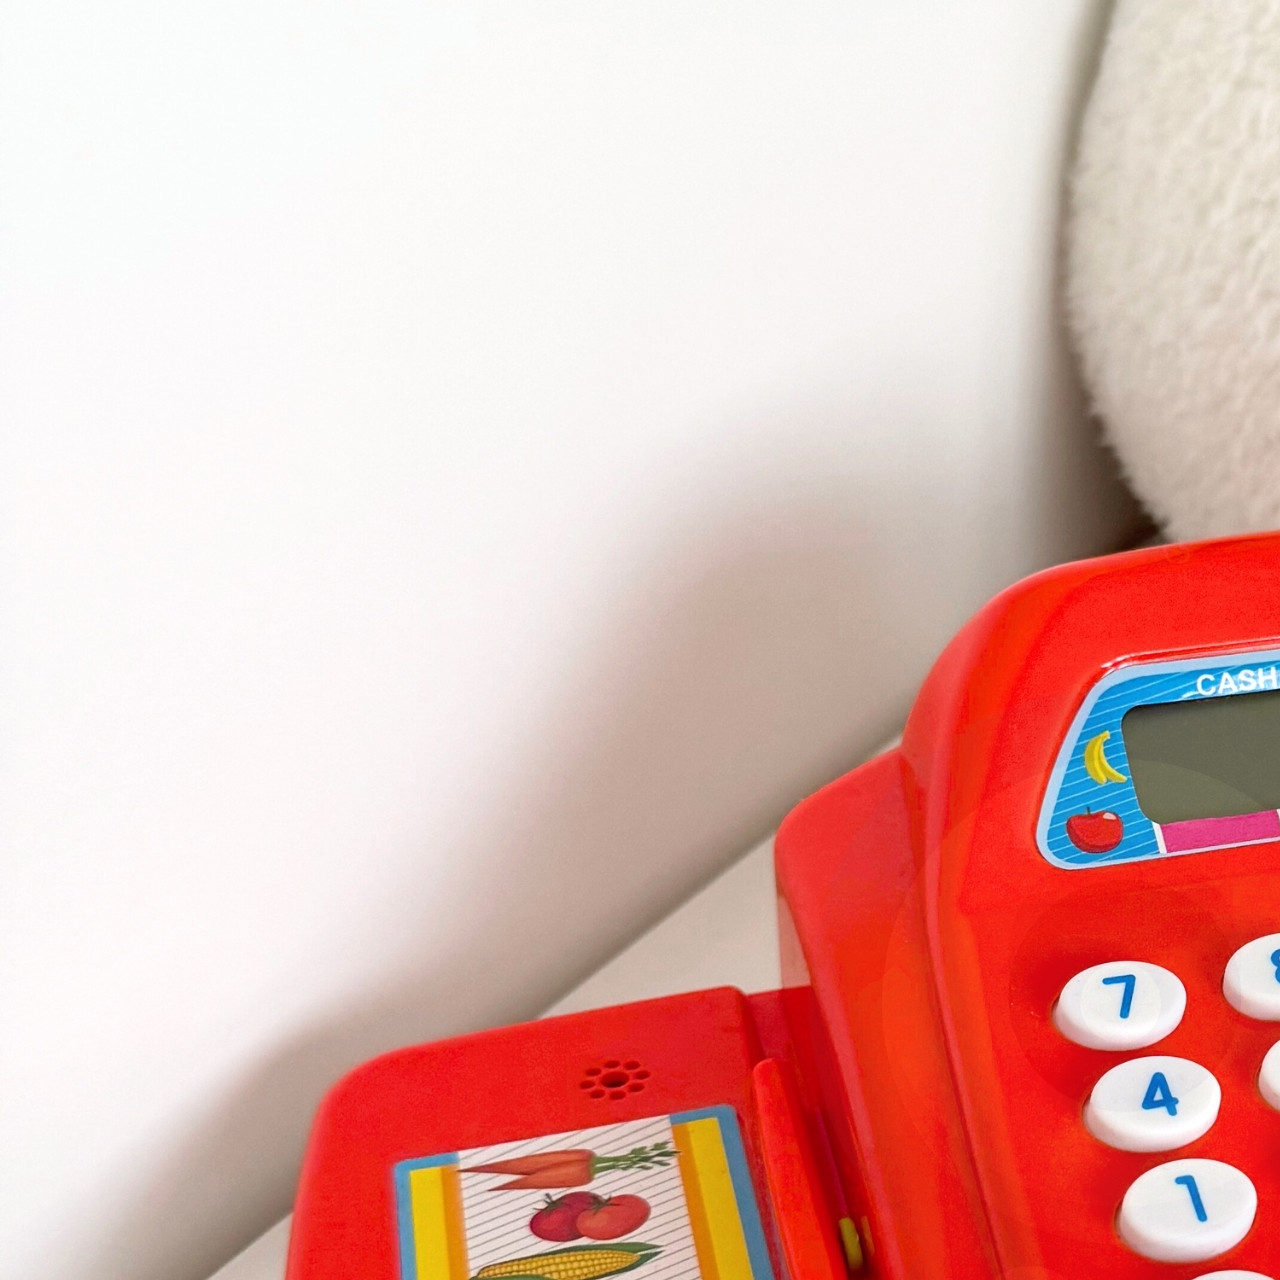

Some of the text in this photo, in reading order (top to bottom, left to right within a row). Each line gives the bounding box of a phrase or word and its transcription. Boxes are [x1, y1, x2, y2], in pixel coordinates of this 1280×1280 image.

[1195, 666, 1279, 697] CASH
[1102, 974, 1136, 1019] 7
[1141, 1072, 1179, 1116] 4
[1175, 1175, 1208, 1222] 1
